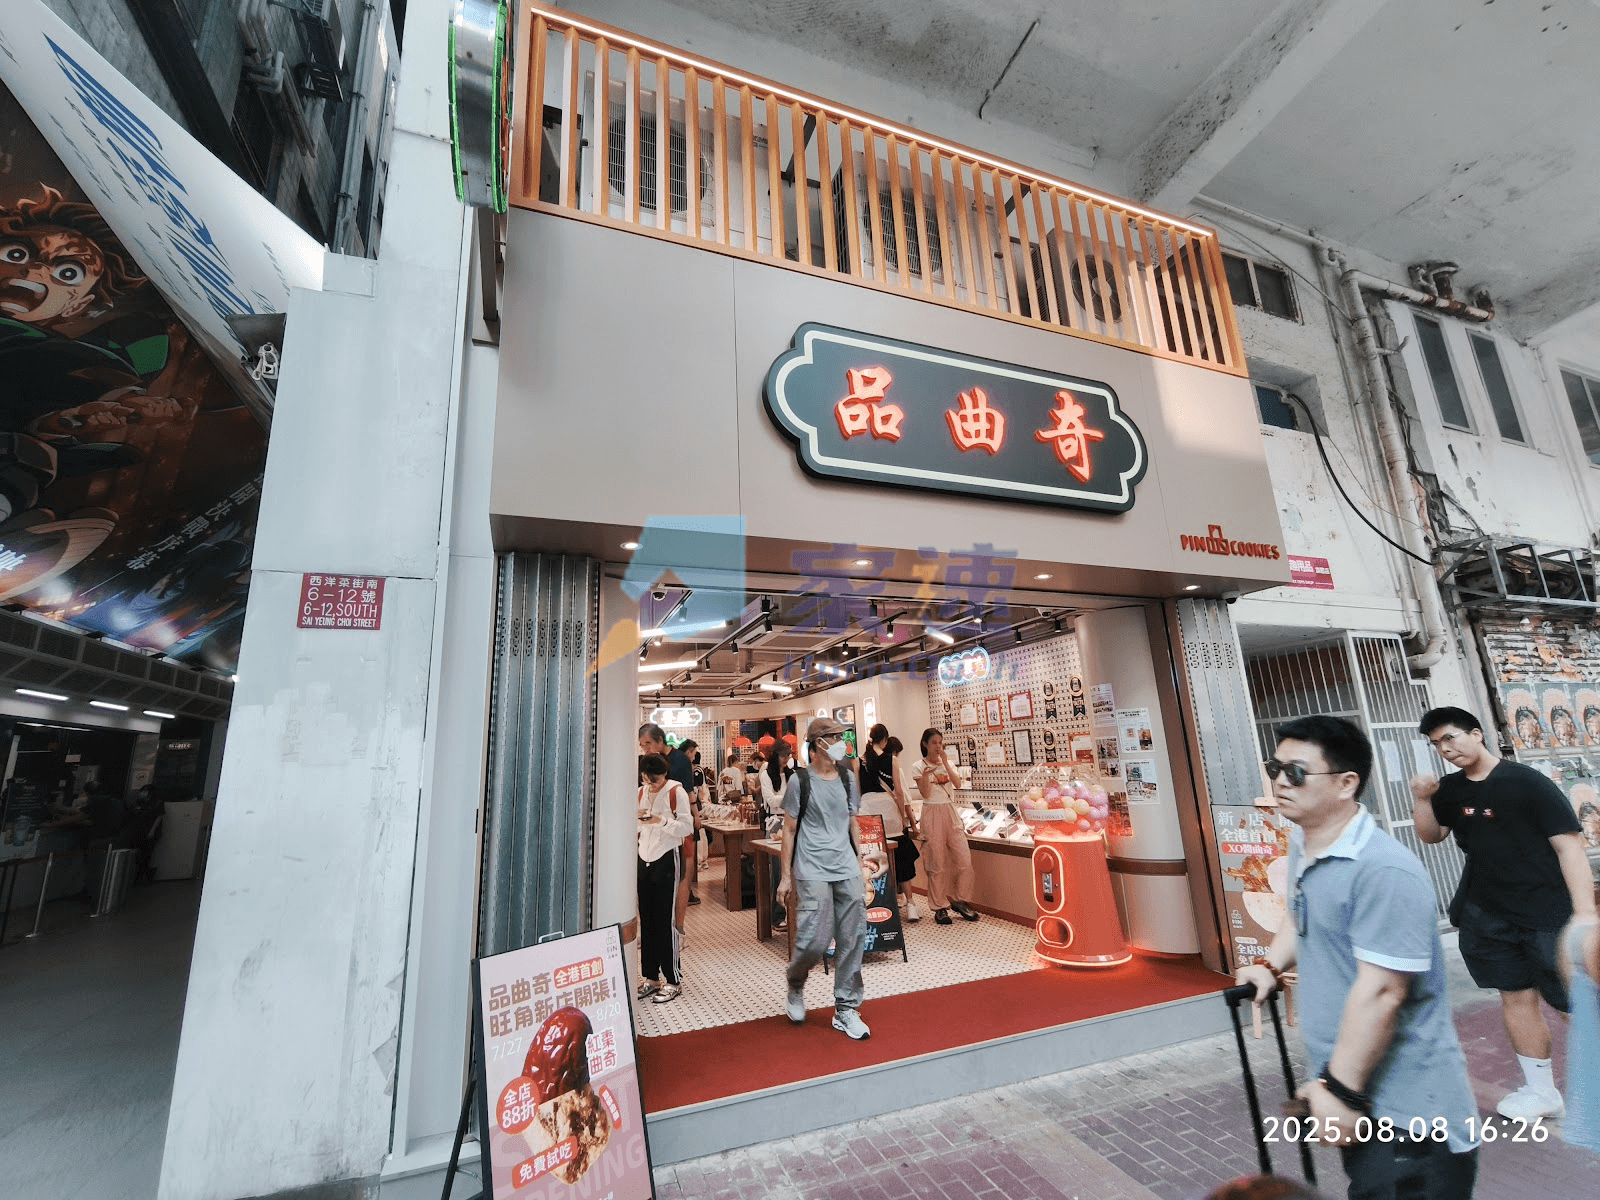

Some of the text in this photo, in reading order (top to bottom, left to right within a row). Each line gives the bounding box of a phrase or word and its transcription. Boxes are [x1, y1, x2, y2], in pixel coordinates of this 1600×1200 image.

[835, 365, 1104, 483] 品曲奇
[126, 473, 264, 570] 開決戰序幕
[1229, 540, 1280, 560] COOKIES
[309, 575, 378, 589] 西洋菜街南
[301, 616, 377, 628] SAI YEUNG CHOI STREET
[554, 959, 603, 987] 全港首創
[488, 971, 552, 1012] 品曲奇
[587, 1029, 615, 1056] 紅棗
[590, 1049, 616, 1075] 曲奇
[503, 1083, 531, 1108] 全店
[502, 1098, 536, 1129] 88折
[519, 1142, 573, 1184] 免費試吃
